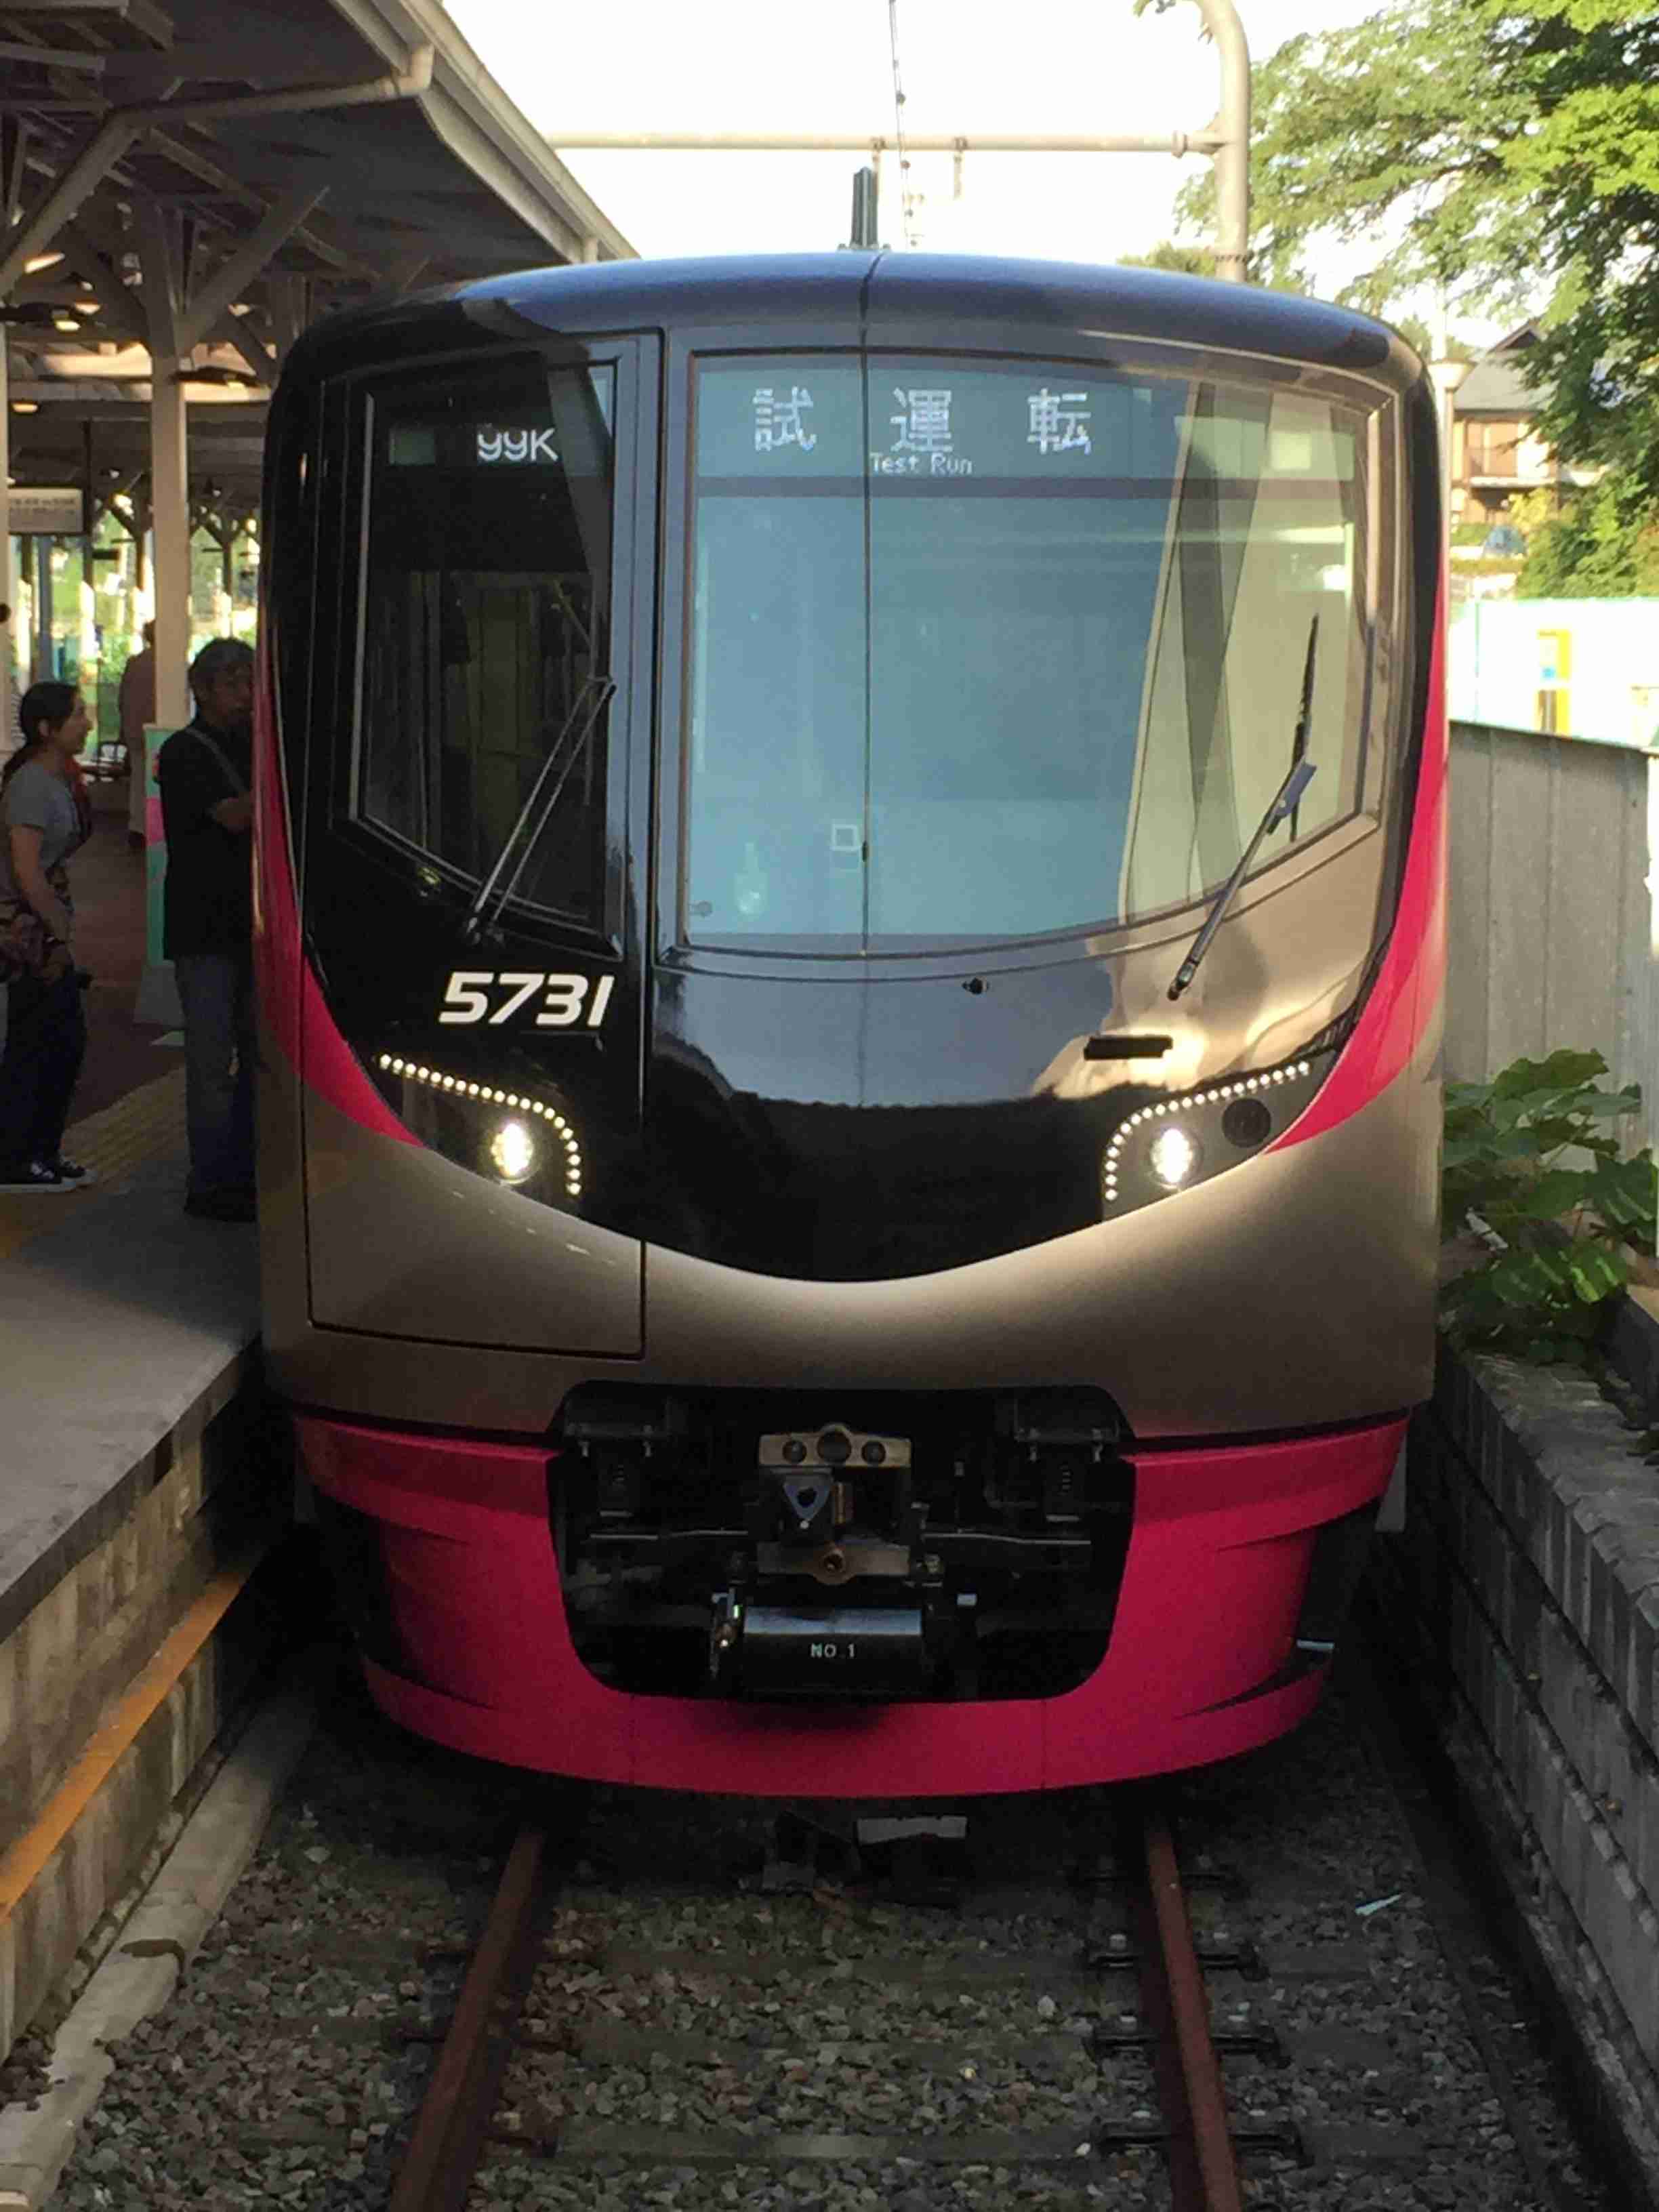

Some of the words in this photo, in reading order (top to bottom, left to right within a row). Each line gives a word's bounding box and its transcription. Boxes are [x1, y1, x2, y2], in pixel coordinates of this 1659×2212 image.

[752, 386, 1092, 455] 試運転
[869, 451, 920, 474] Test
[930, 451, 974, 476] Run
[438, 971, 615, 1027] 5731
